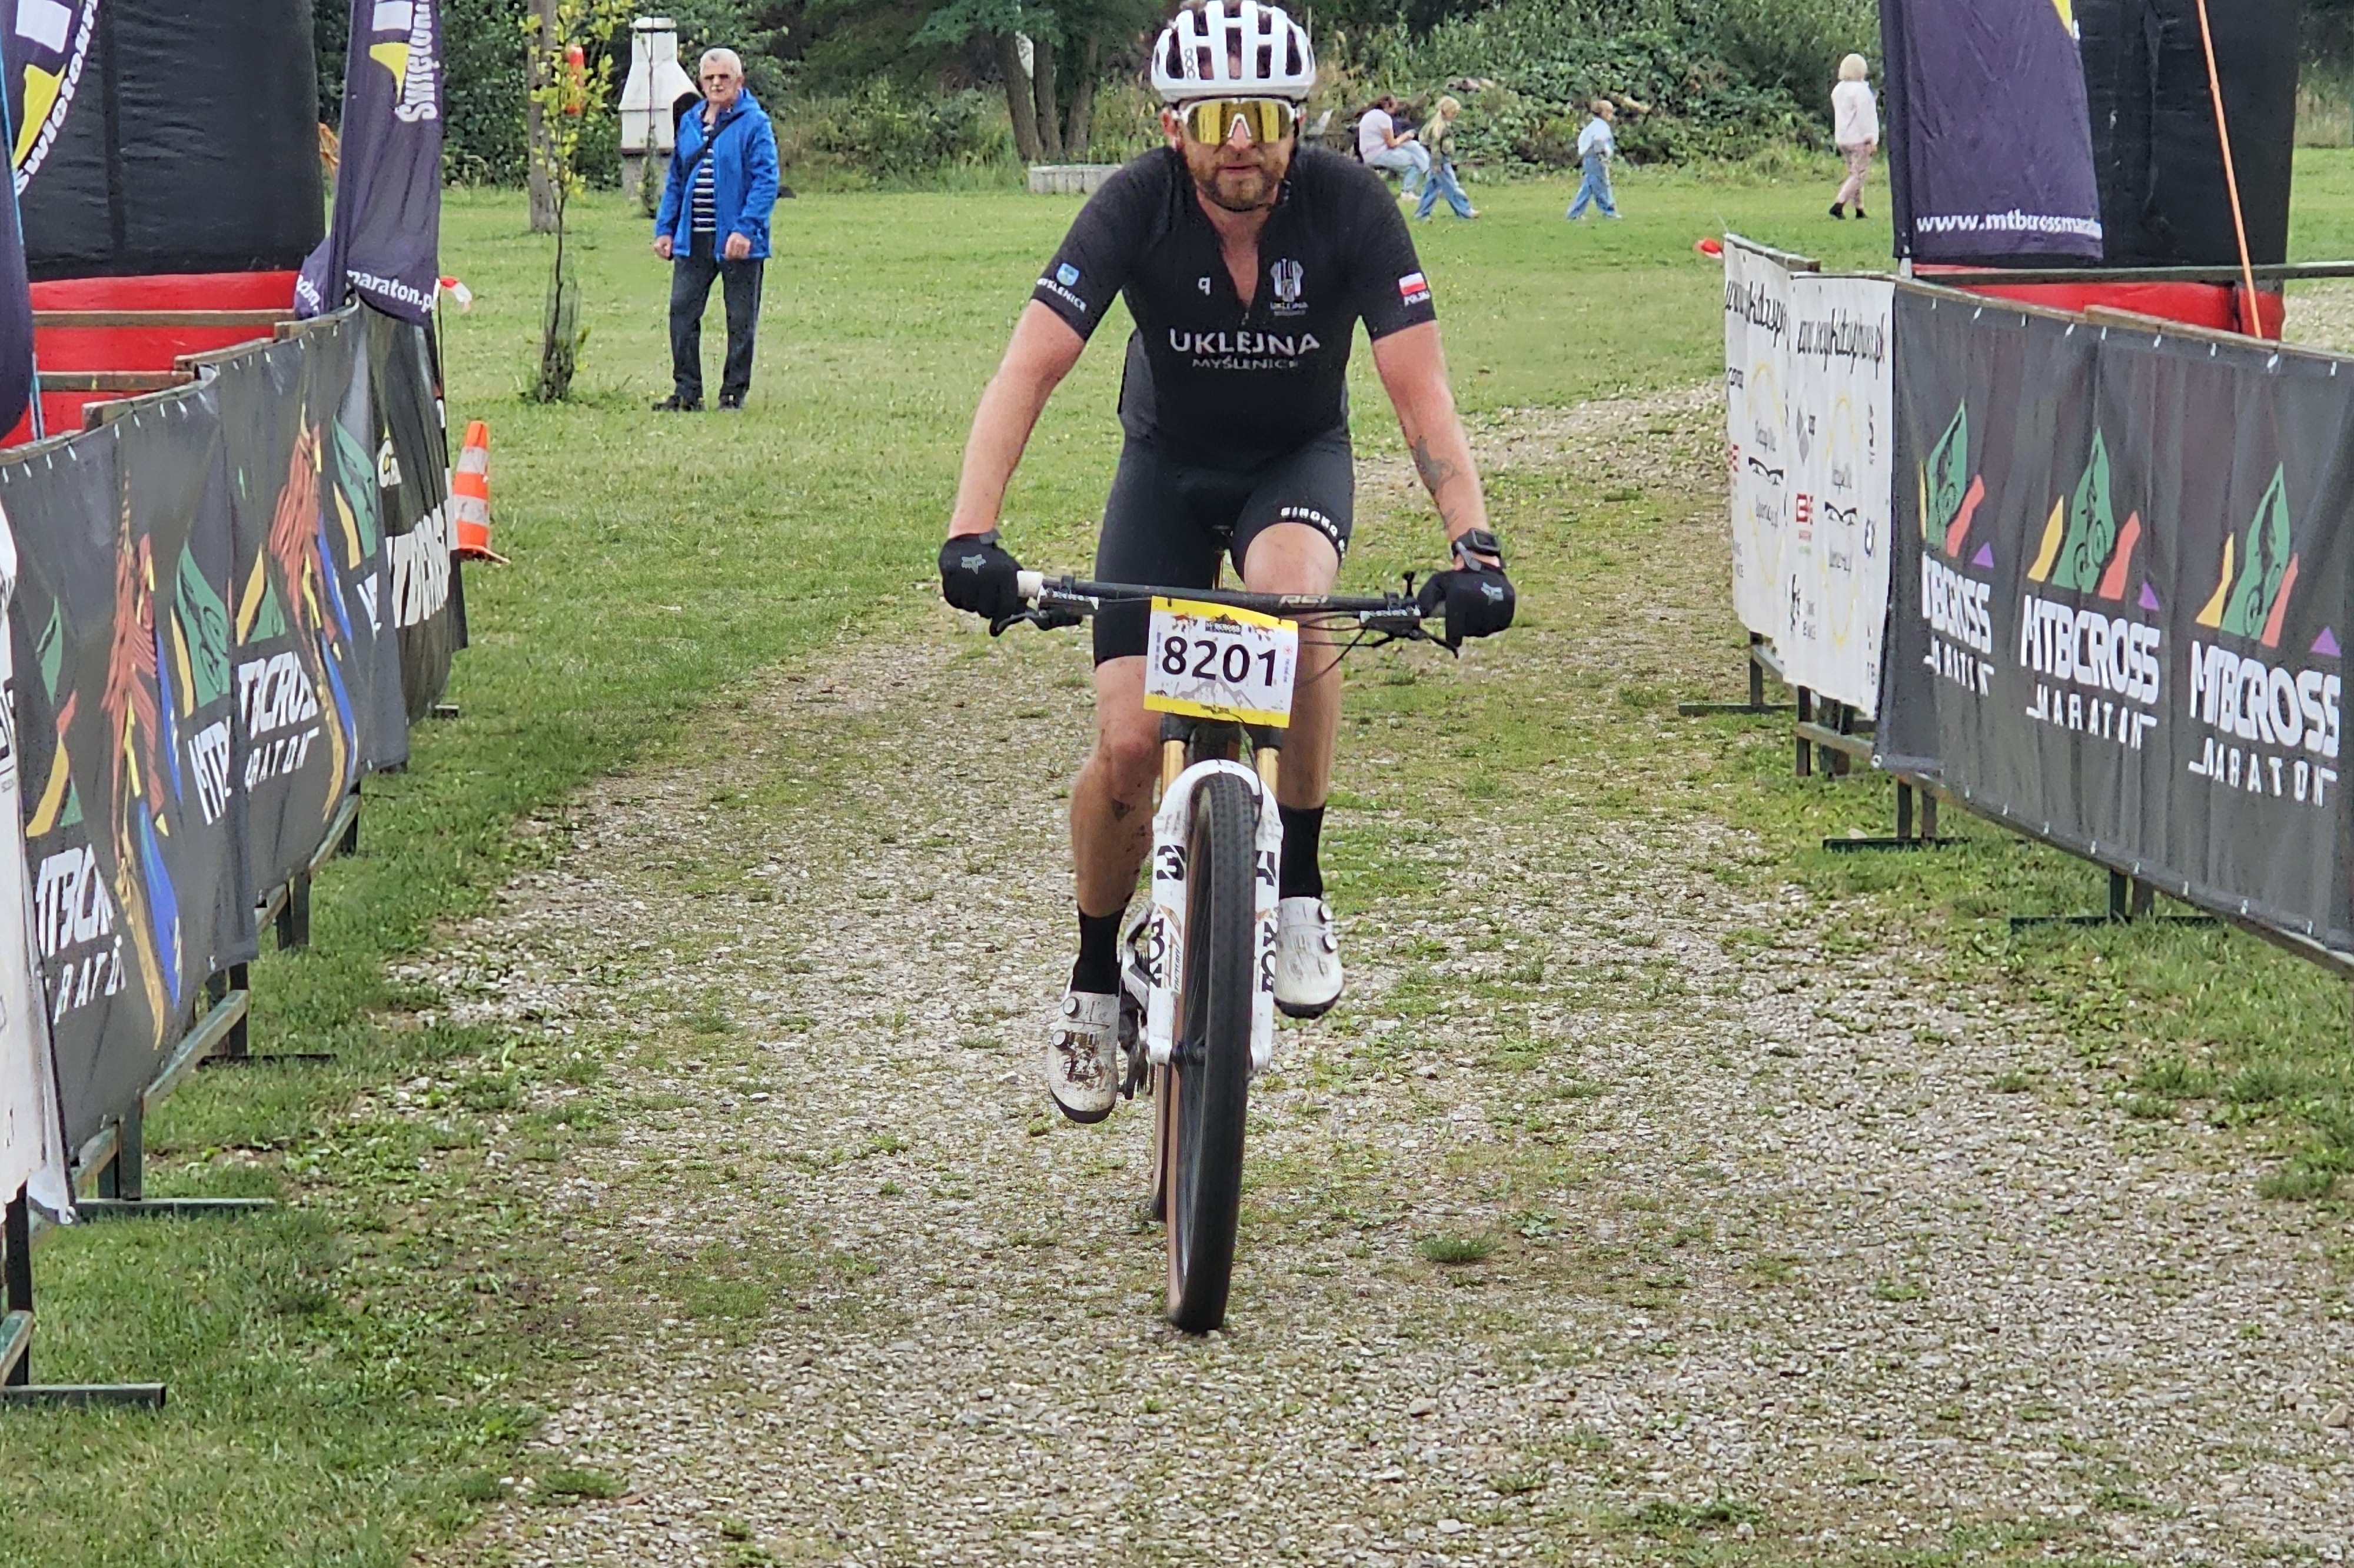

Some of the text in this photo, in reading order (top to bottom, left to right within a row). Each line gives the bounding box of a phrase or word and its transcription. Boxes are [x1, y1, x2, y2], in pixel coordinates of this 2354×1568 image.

[1162, 635, 1276, 687] 8201
[2020, 594, 2160, 705] MTBCROSS
[2189, 640, 2342, 758] MTBCROSS
